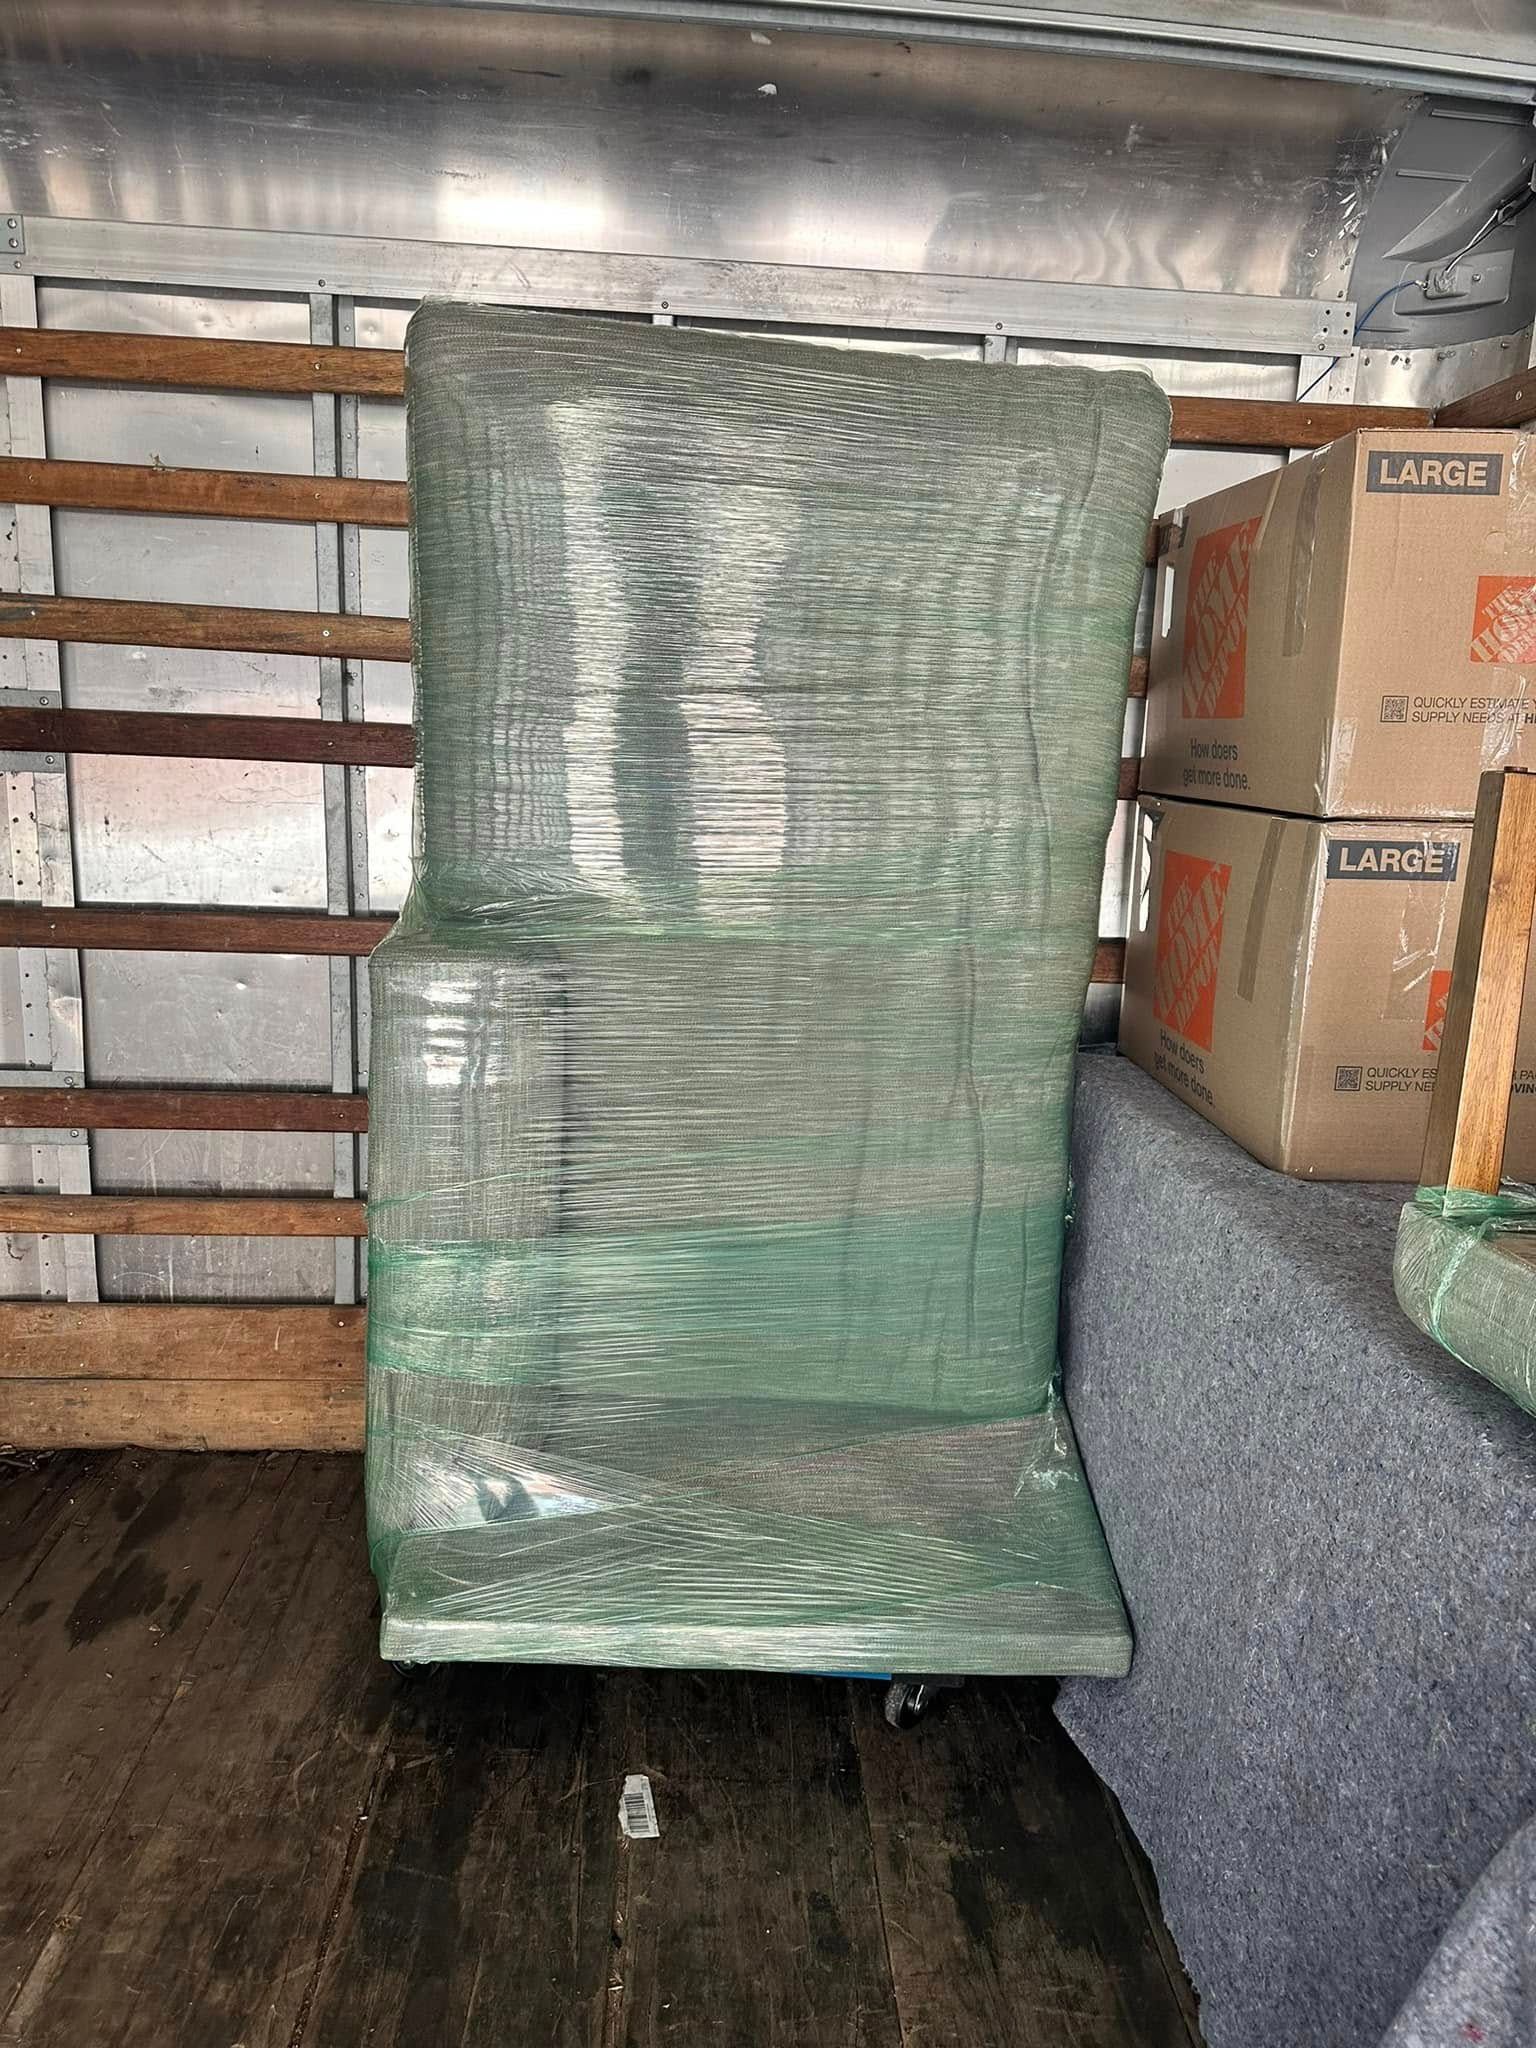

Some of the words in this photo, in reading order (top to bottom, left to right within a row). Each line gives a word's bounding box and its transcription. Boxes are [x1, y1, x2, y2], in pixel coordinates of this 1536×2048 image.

[1380, 458, 1488, 487] LARGE
[1414, 696, 1468, 709] QUICKLY
[1412, 711, 1460, 723] SUPPLY
[1463, 712, 1504, 723] NEEDS
[1190, 738, 1209, 758] How
[1211, 739, 1238, 760] doers
[1183, 765, 1196, 787] get
[1198, 769, 1221, 786] more
[1223, 768, 1251, 790] done.
[1340, 847, 1445, 873] LARGE
[1160, 1028, 1178, 1055] How
[1180, 1043, 1204, 1074] doers
[1168, 1062, 1189, 1087] more
[1367, 1067, 1420, 1078] QUICKLY
[1365, 1080, 1413, 1092] SUPPLY
